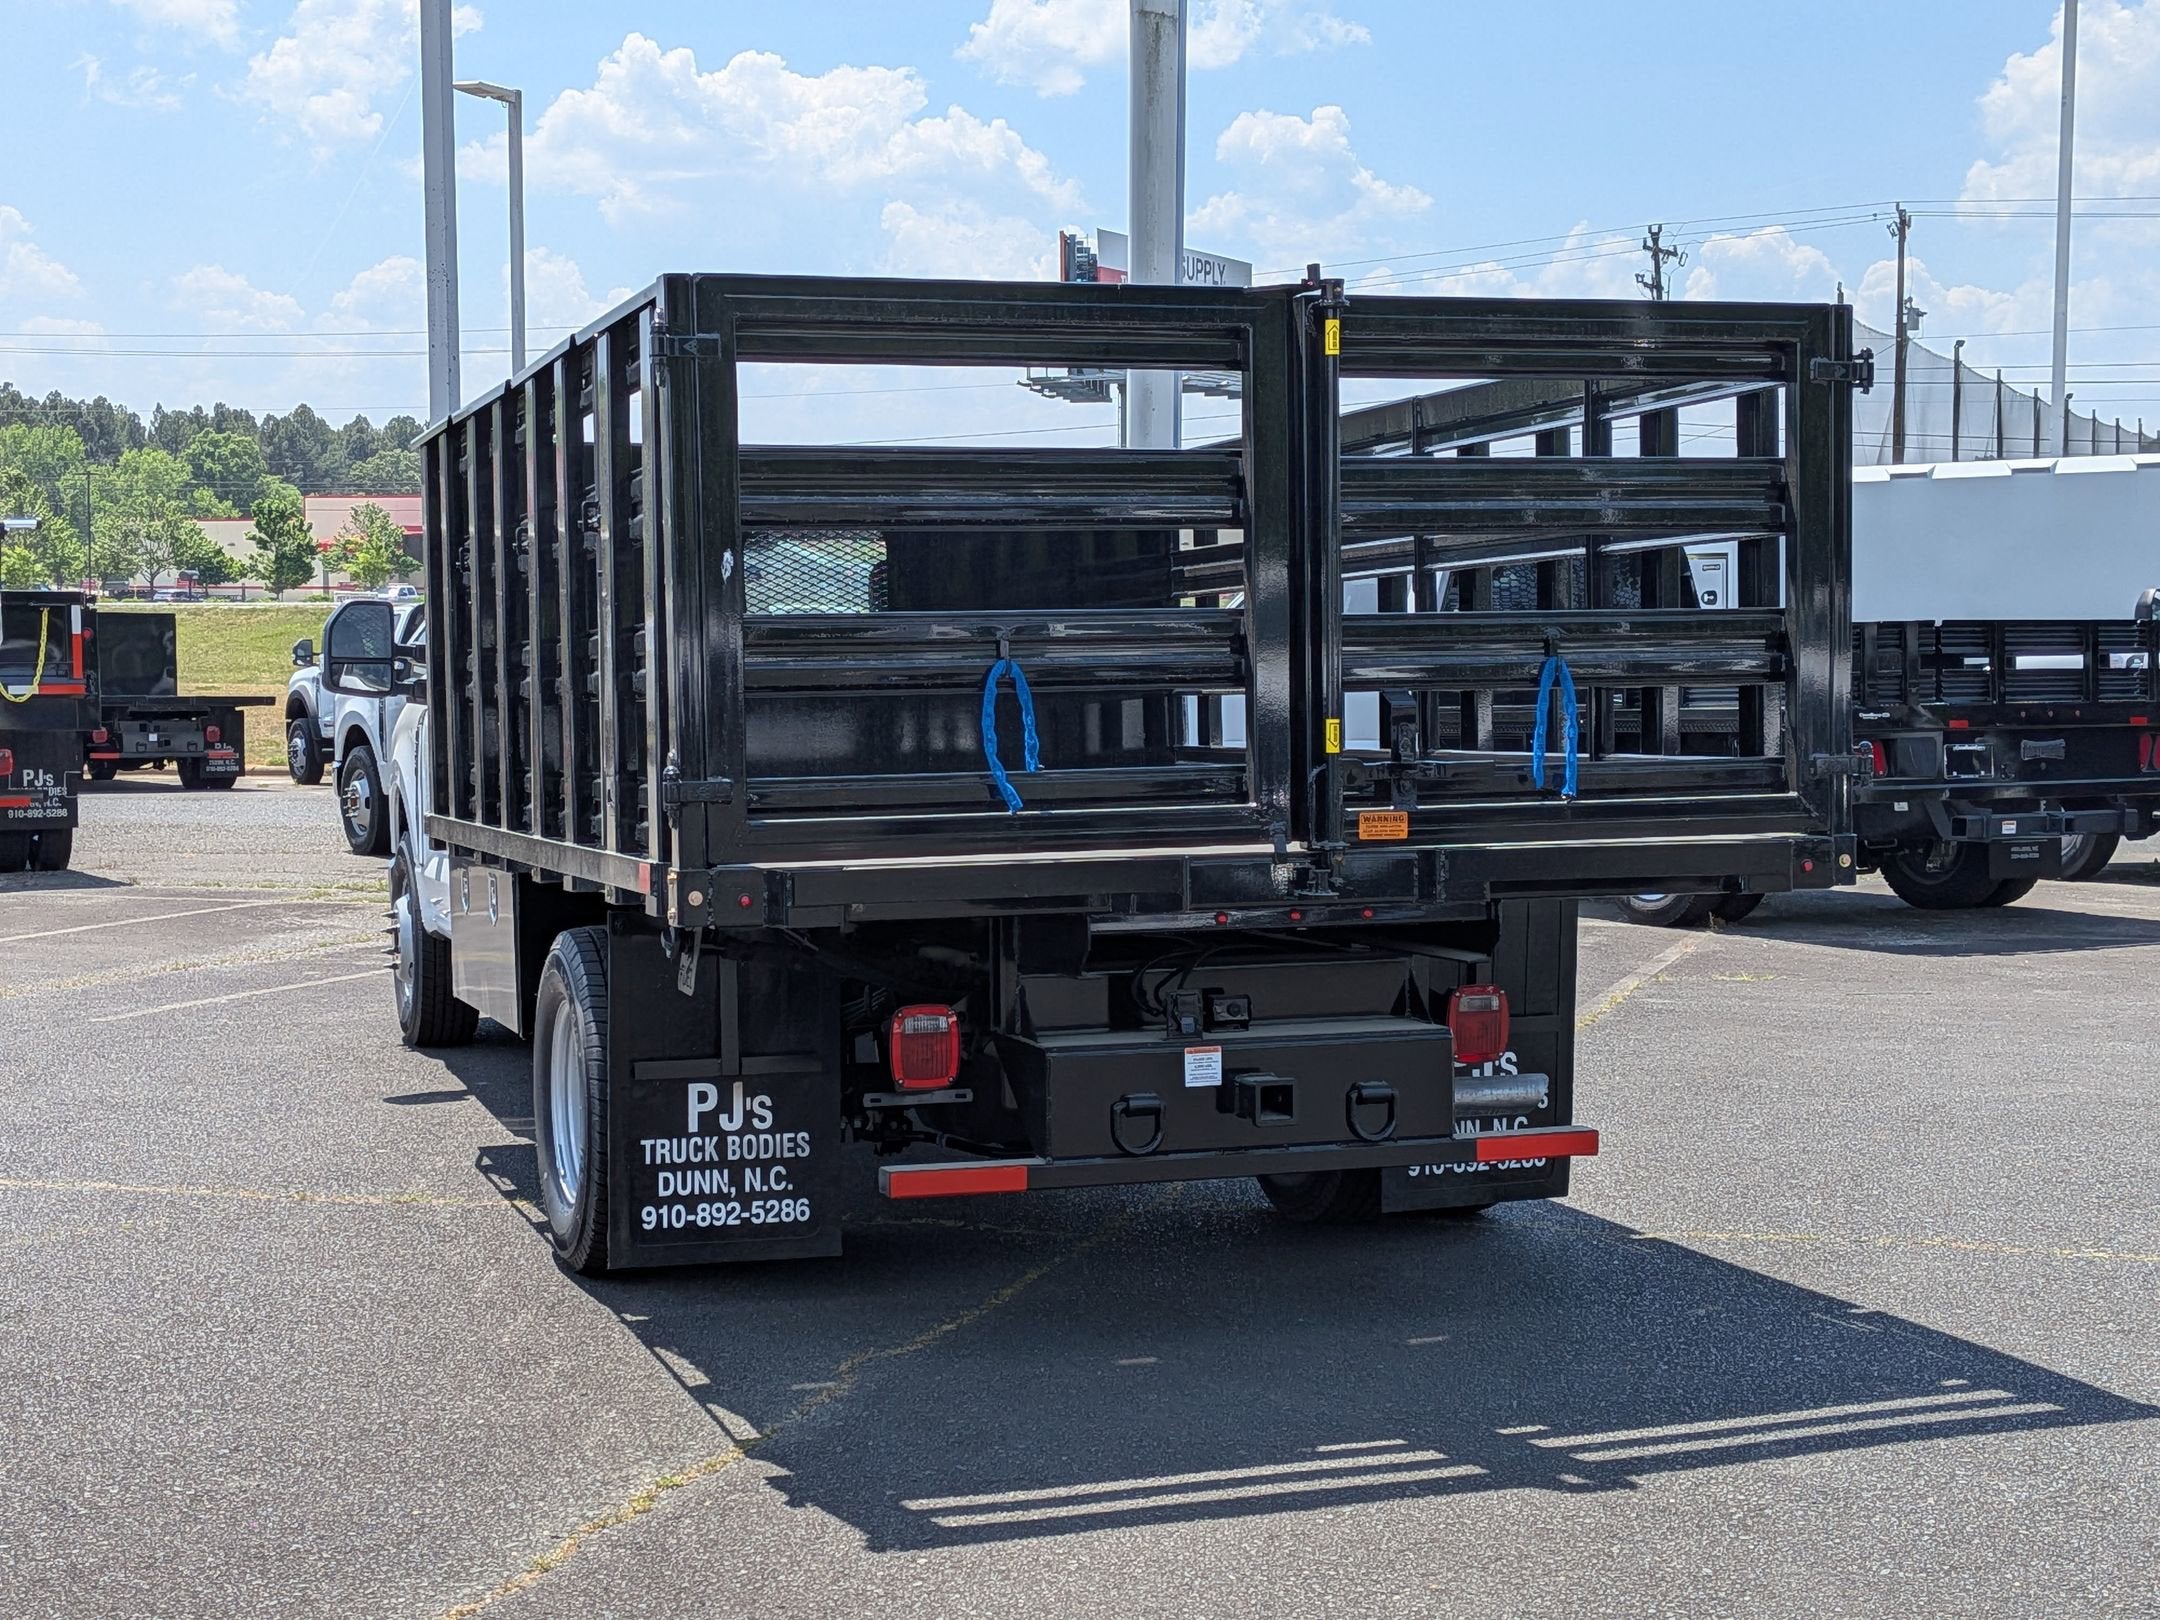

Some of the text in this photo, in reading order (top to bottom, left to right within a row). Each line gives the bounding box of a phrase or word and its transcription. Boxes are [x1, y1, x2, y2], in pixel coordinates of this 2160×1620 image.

[1363, 814, 1405, 824] WARNING
[687, 1081, 773, 1133] PJ's
[640, 1132, 810, 1165] TRUCK BODIES
[658, 1165, 794, 1198] DUNN, N.C.
[641, 1198, 810, 1230] 910-892-5286
